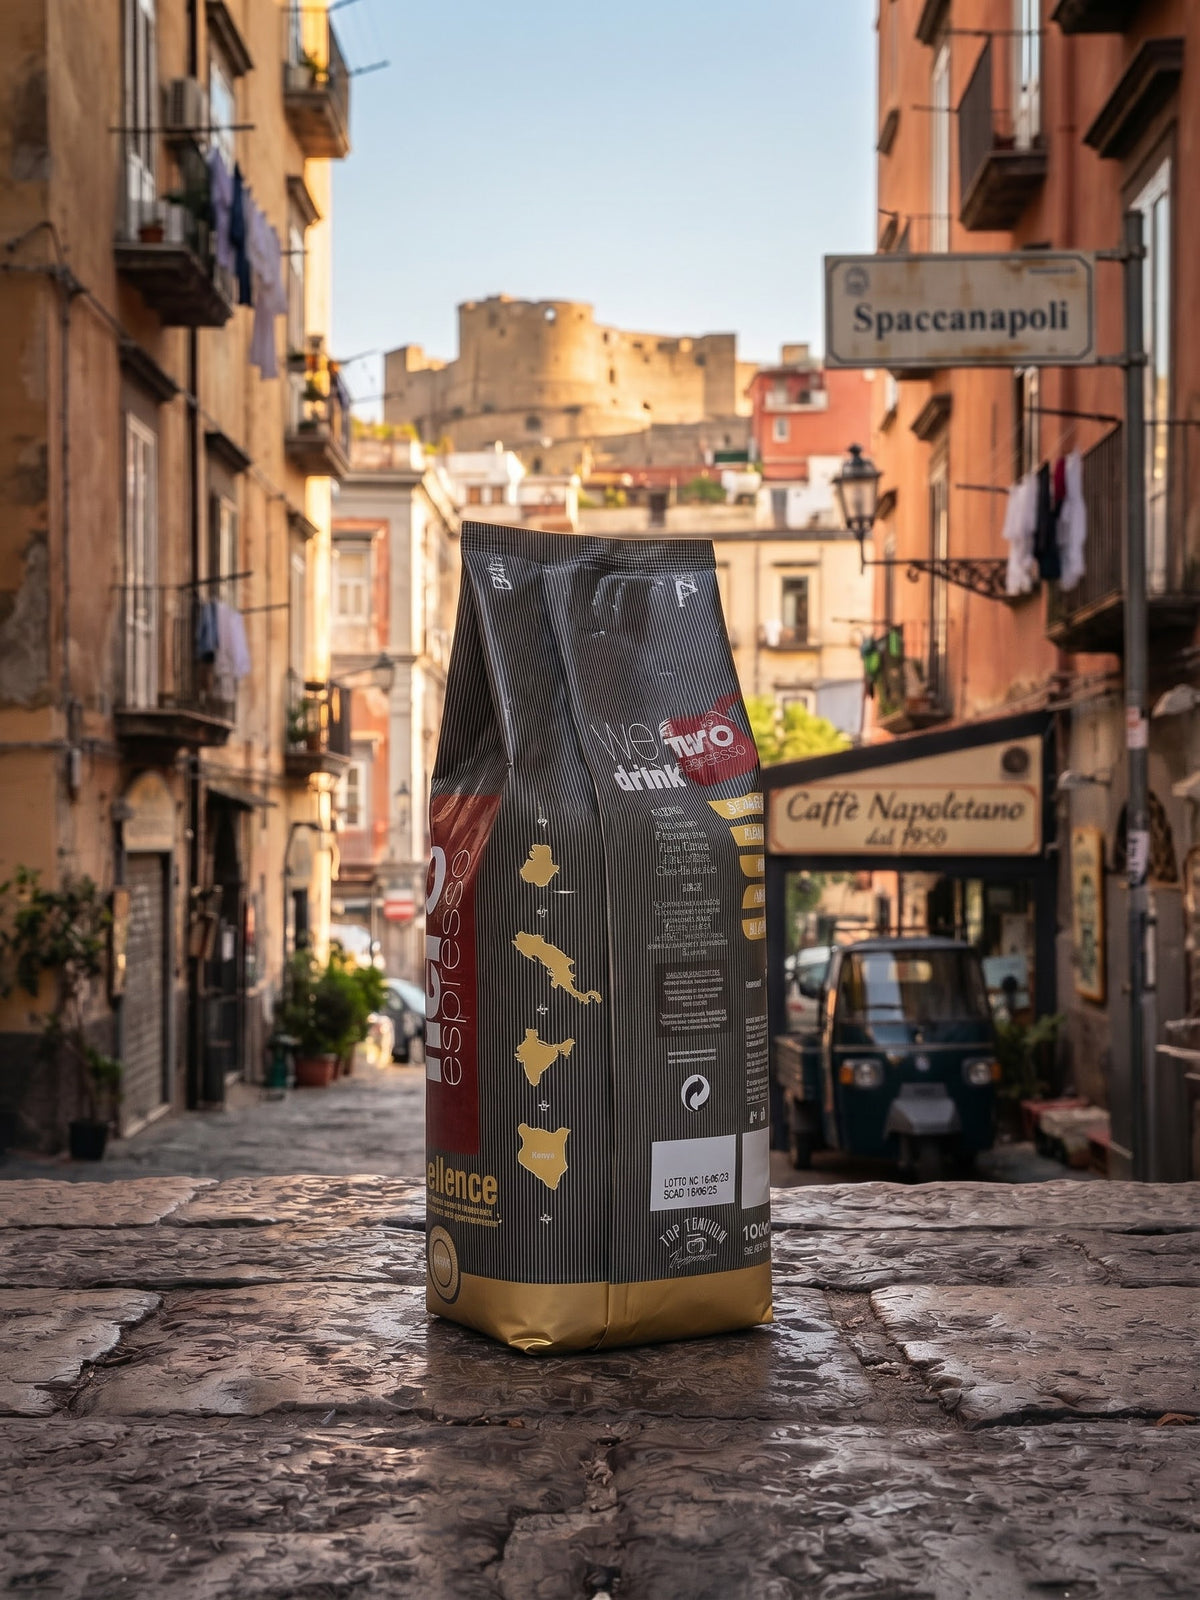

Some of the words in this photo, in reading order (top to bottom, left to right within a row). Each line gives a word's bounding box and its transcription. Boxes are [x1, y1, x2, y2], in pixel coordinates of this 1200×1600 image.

[853, 301, 1069, 340] Spaccanapoli
[614, 764, 687, 791] drink
[786, 790, 858, 828] Caffè
[867, 791, 1025, 828] Napoletano
[865, 828, 895, 845] dal
[902, 826, 948, 846] 1950
[442, 849, 471, 1087] espresso
[427, 1155, 499, 1206] ellence
[664, 1176, 687, 1188] LOTTO
[689, 1175, 699, 1185] NC
[664, 1188, 685, 1200] SCAD
[659, 1223, 680, 1247] TOP
